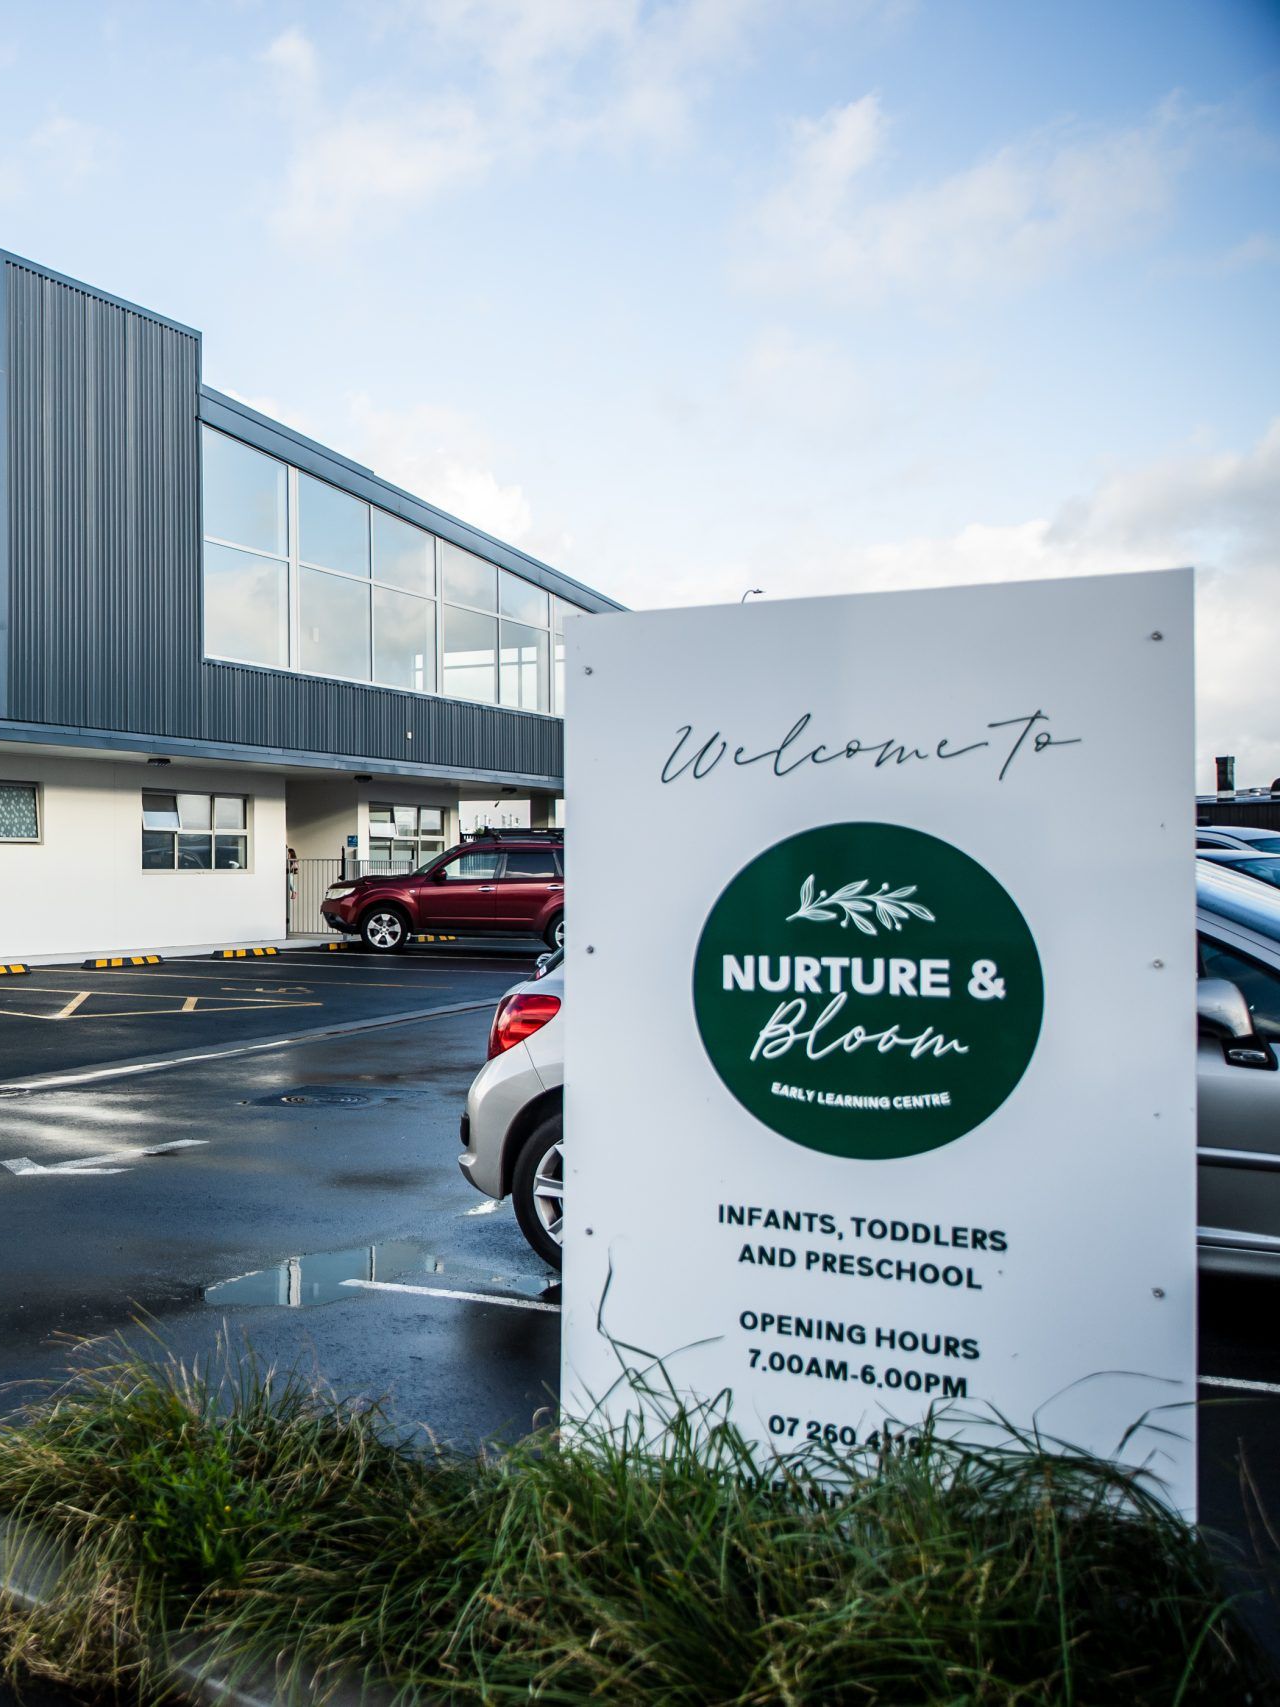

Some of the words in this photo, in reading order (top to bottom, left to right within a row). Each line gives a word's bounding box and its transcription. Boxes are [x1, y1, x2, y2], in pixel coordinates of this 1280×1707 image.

[661, 713, 989, 784] Welcome
[722, 954, 952, 997] NURTURE
[967, 959, 1006, 1000] &
[750, 991, 969, 1061] Bloom
[771, 1082, 815, 1104] EARLY
[817, 1091, 891, 1110] LEARNING
[892, 1091, 952, 1110] CENTRE
[718, 1204, 844, 1241] INFANTS,
[850, 1216, 1008, 1252] TODDLERS
[738, 1243, 796, 1268] AND
[805, 1250, 983, 1290] PRESCHOOL
[739, 1310, 866, 1345] OPENING
[875, 1327, 980, 1360] HOURS
[748, 1348, 968, 1398] 7.00AM-6.00PM
[768, 1414, 800, 1437] 07
[806, 1420, 857, 1447] 260
